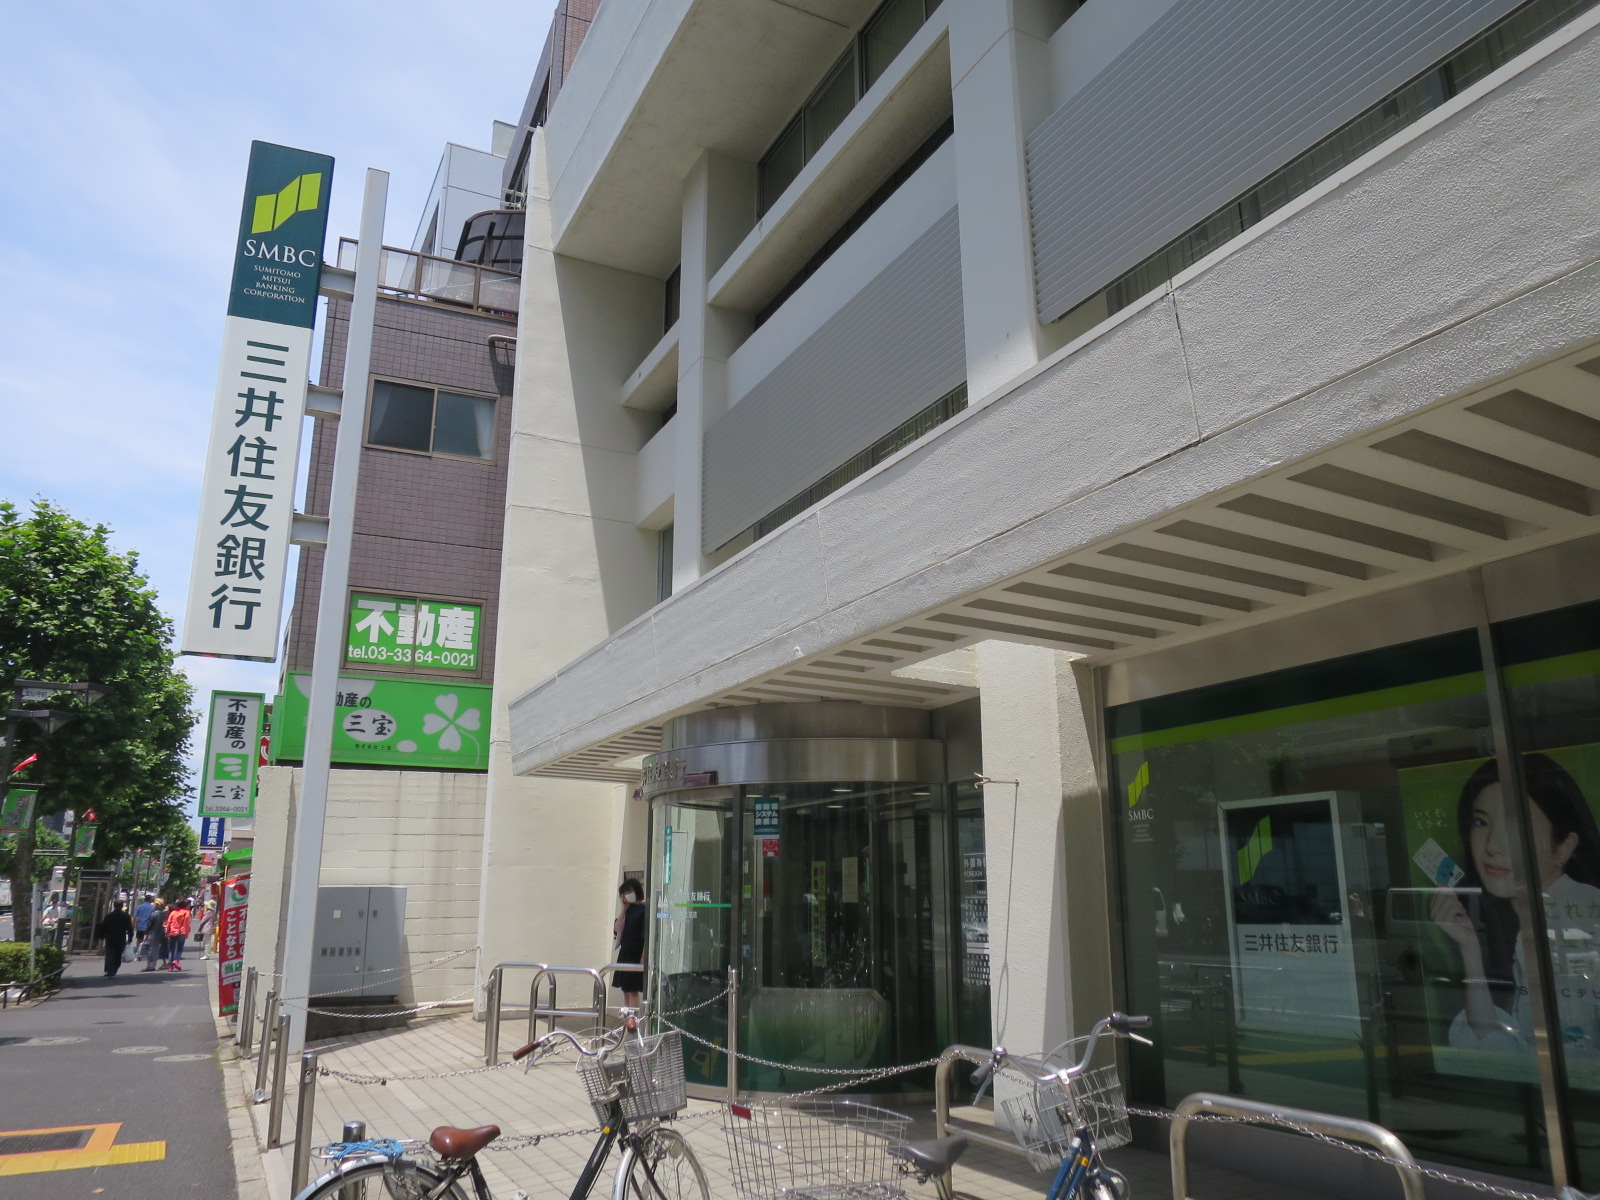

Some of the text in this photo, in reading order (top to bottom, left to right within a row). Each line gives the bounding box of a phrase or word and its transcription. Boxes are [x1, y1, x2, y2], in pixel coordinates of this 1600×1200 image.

[244, 239, 316, 268] SMBC
[253, 264, 301, 279] SUMITOMO
[261, 274, 291, 285] MITSUI
[243, 288, 305, 304] CORPORATION
[255, 281, 296, 294] BANKING
[208, 340, 290, 631] 三井住友銀行
[355, 599, 475, 650] 不動産
[224, 698, 248, 750] 不動産の
[345, 714, 394, 736] 三宝
[211, 785, 246, 800] 三宝
[1128, 808, 1154, 821] SMBC
[226, 910, 237, 959] ことなら
[1244, 933, 1339, 954] 三井住友銀行
